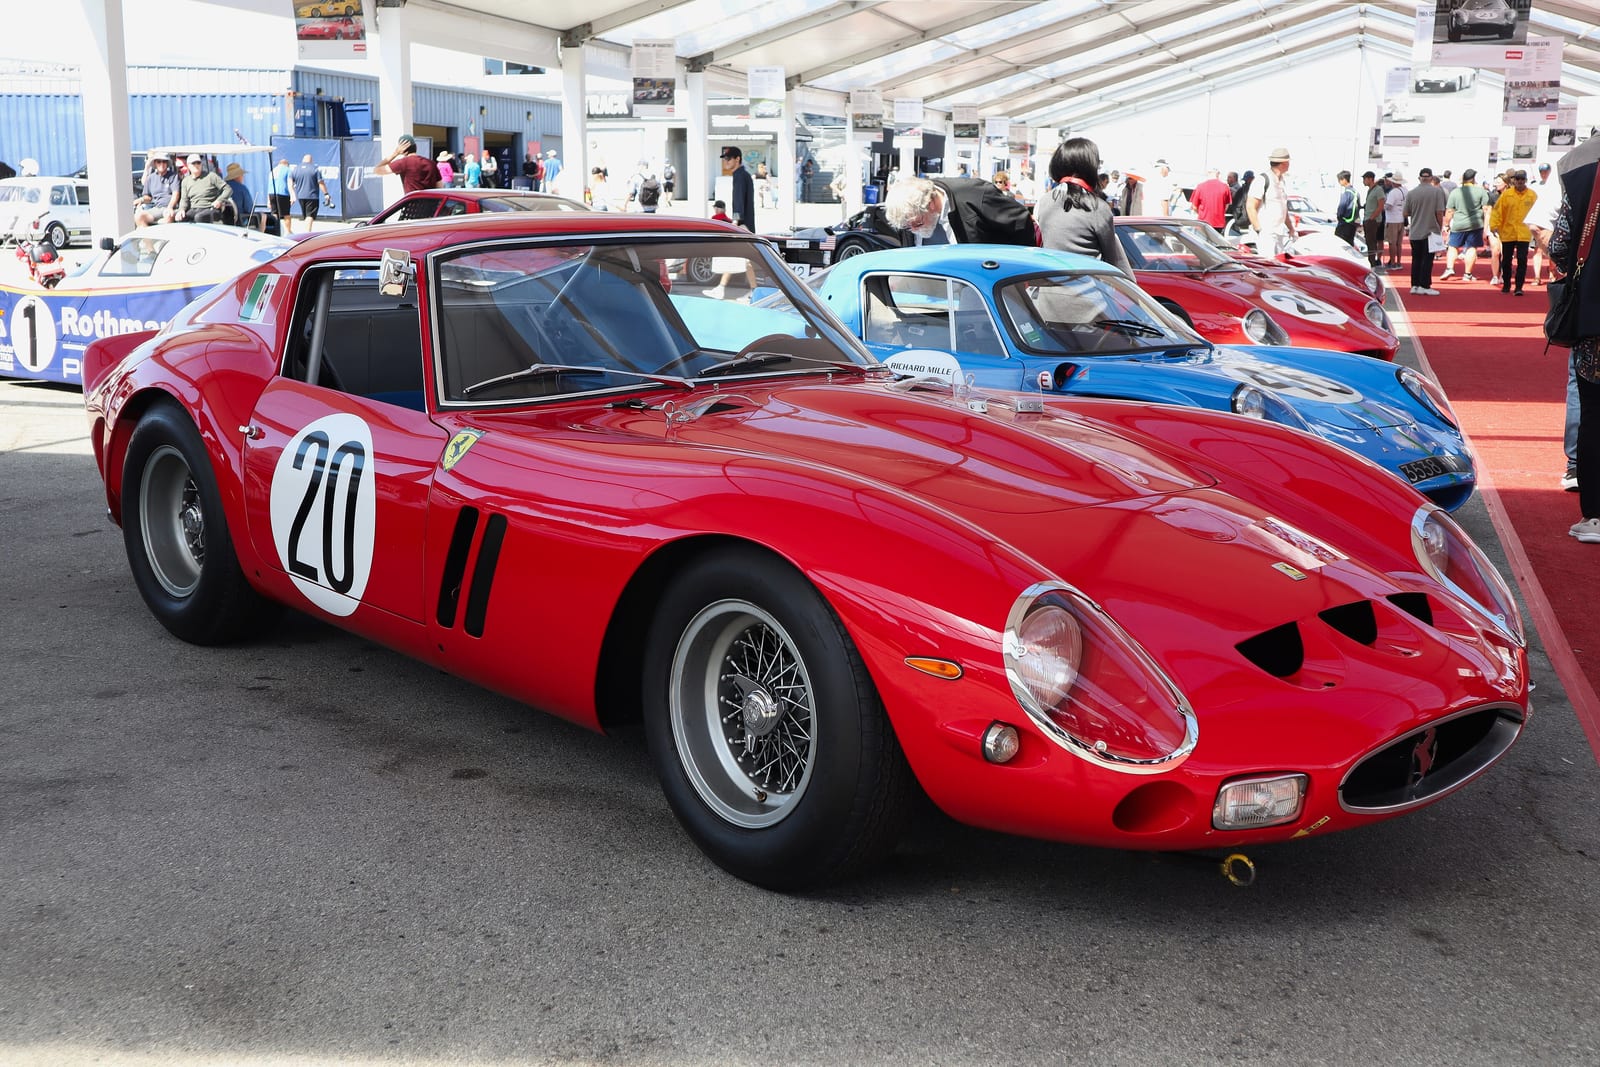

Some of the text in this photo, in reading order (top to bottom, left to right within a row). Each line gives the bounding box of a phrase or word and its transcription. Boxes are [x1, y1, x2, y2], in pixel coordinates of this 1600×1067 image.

[23, 300, 38, 367] 1
[890, 362, 952, 376] RICHARD MILLE
[1041, 373, 1050, 388] E
[1400, 459, 1442, 482] 3538
[287, 430, 366, 594] 20
